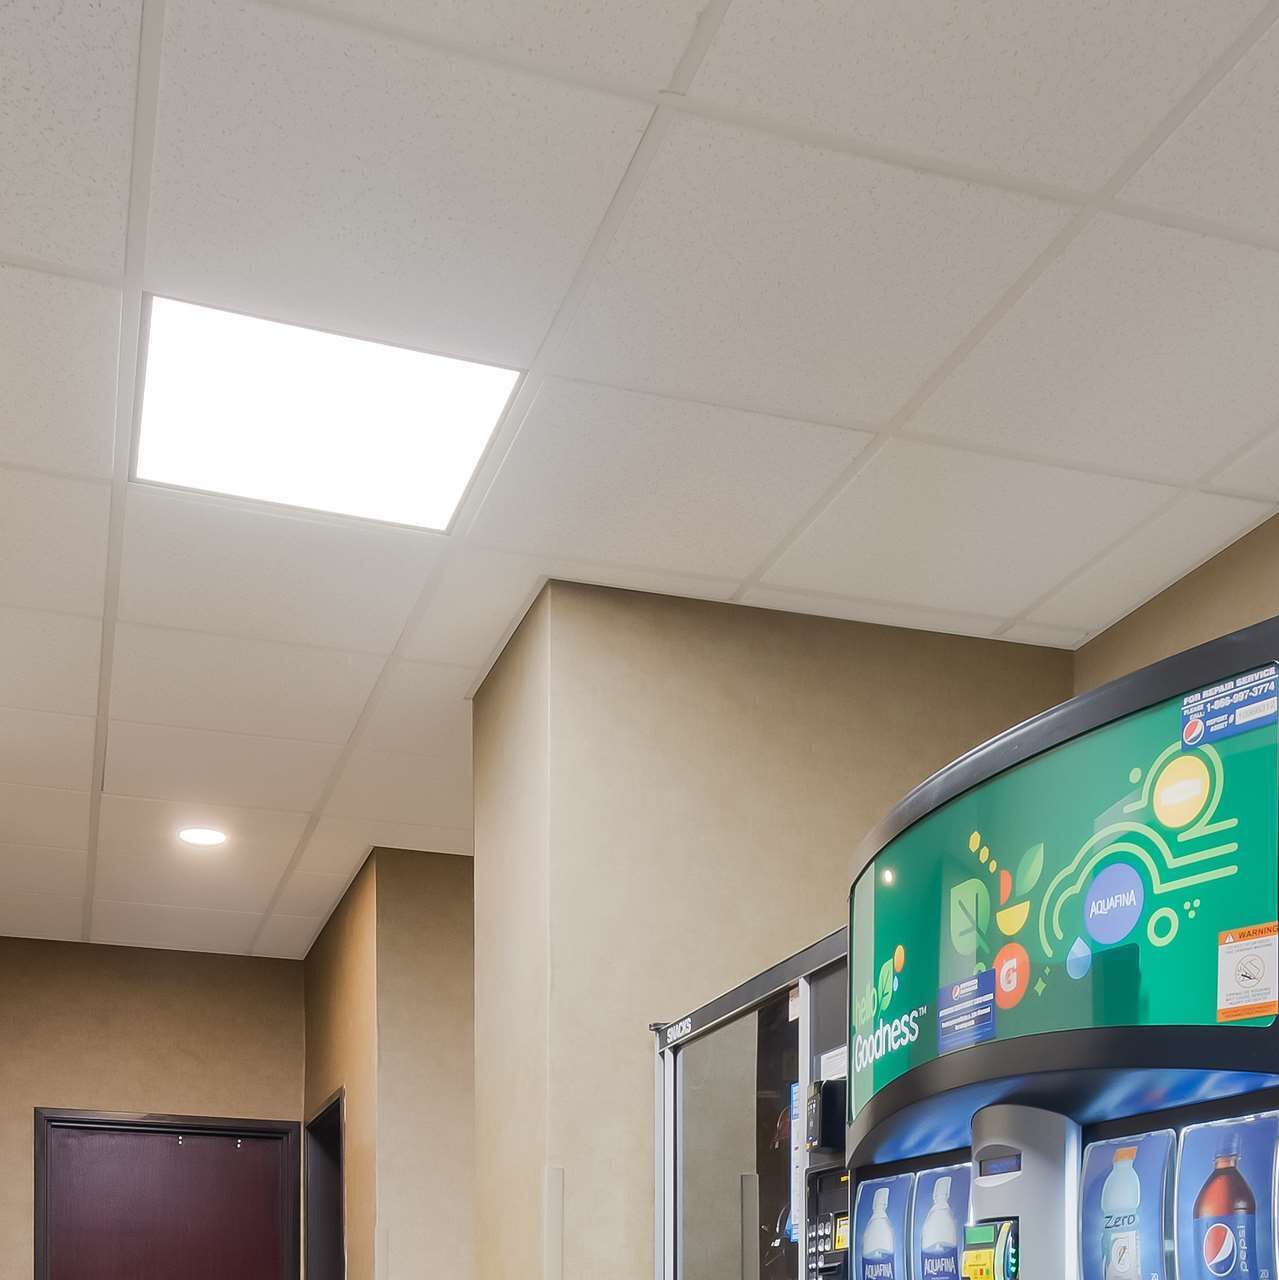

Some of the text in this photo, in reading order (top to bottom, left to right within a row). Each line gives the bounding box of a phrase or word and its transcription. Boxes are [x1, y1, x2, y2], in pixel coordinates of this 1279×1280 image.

[1183, 667, 1276, 706] FOR REPAIR SERVICE
[1089, 889, 1137, 919] AQUAFINA
[1239, 924, 1279, 939] WARNING
[1000, 957, 1017, 992] G
[666, 1017, 691, 1043] SNACKS
[1237, 1225, 1249, 1272] pepsi
[865, 1262, 893, 1280] AQUAFINA
[924, 1256, 956, 1276] AQUAFINA
